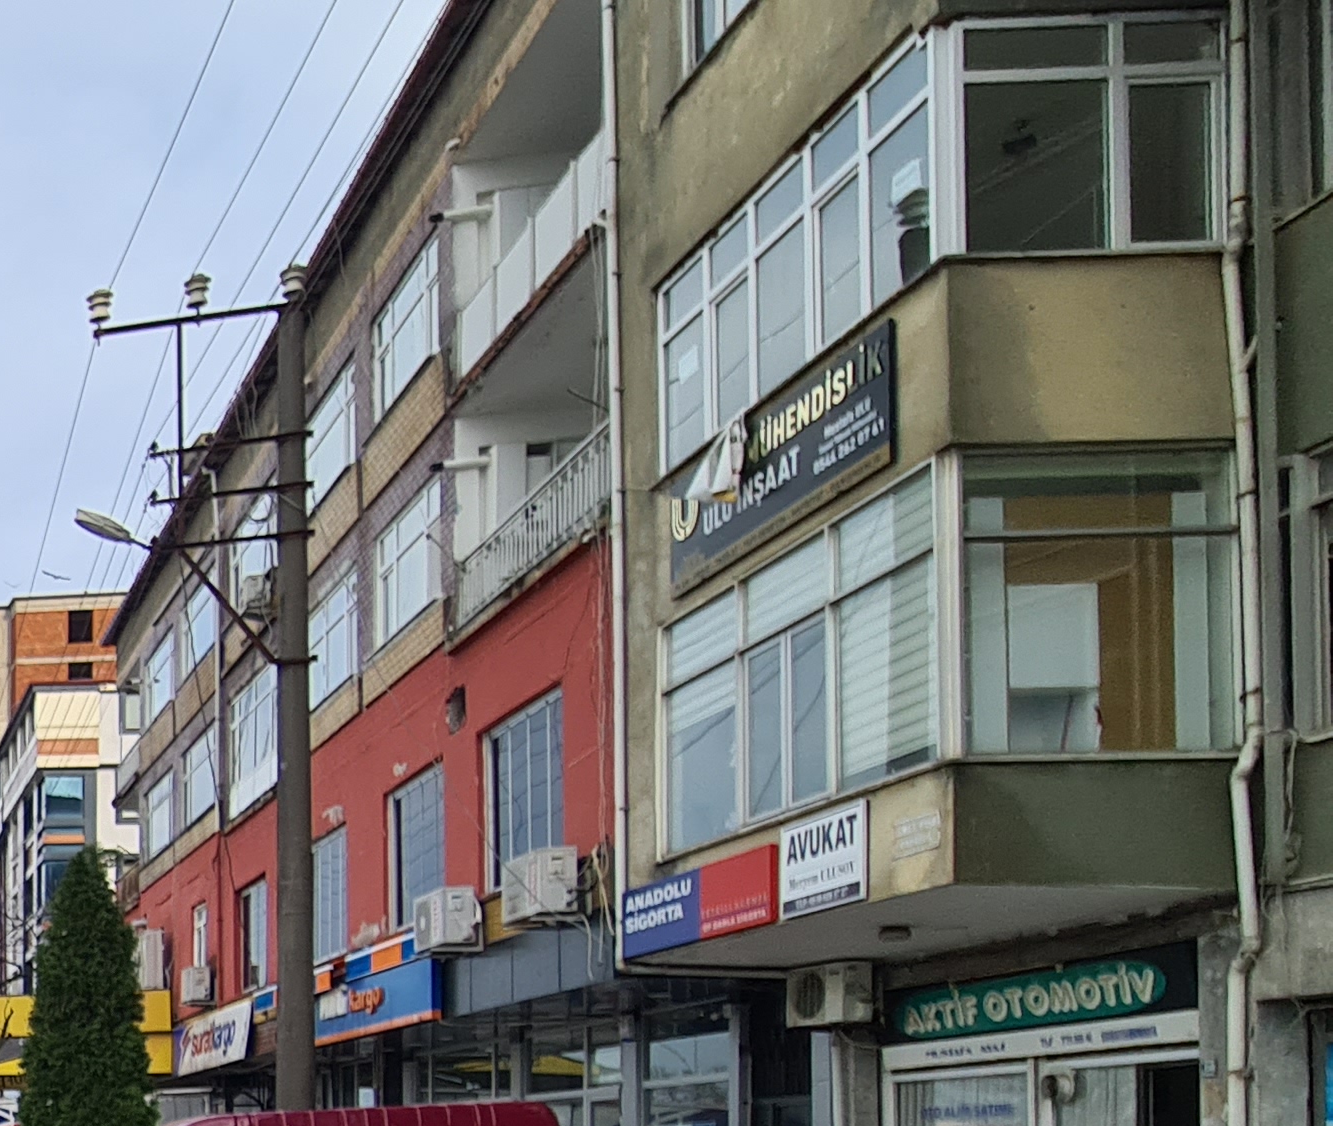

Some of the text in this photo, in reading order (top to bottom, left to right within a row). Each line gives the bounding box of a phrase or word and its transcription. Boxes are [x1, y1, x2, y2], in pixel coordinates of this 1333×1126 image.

[786, 813, 857, 866] AVUKAT
[625, 878, 692, 913] ANADOLU
[625, 901, 684, 934] SİGORTA
[904, 962, 1155, 1036] AKTİF OTOMOTİV
